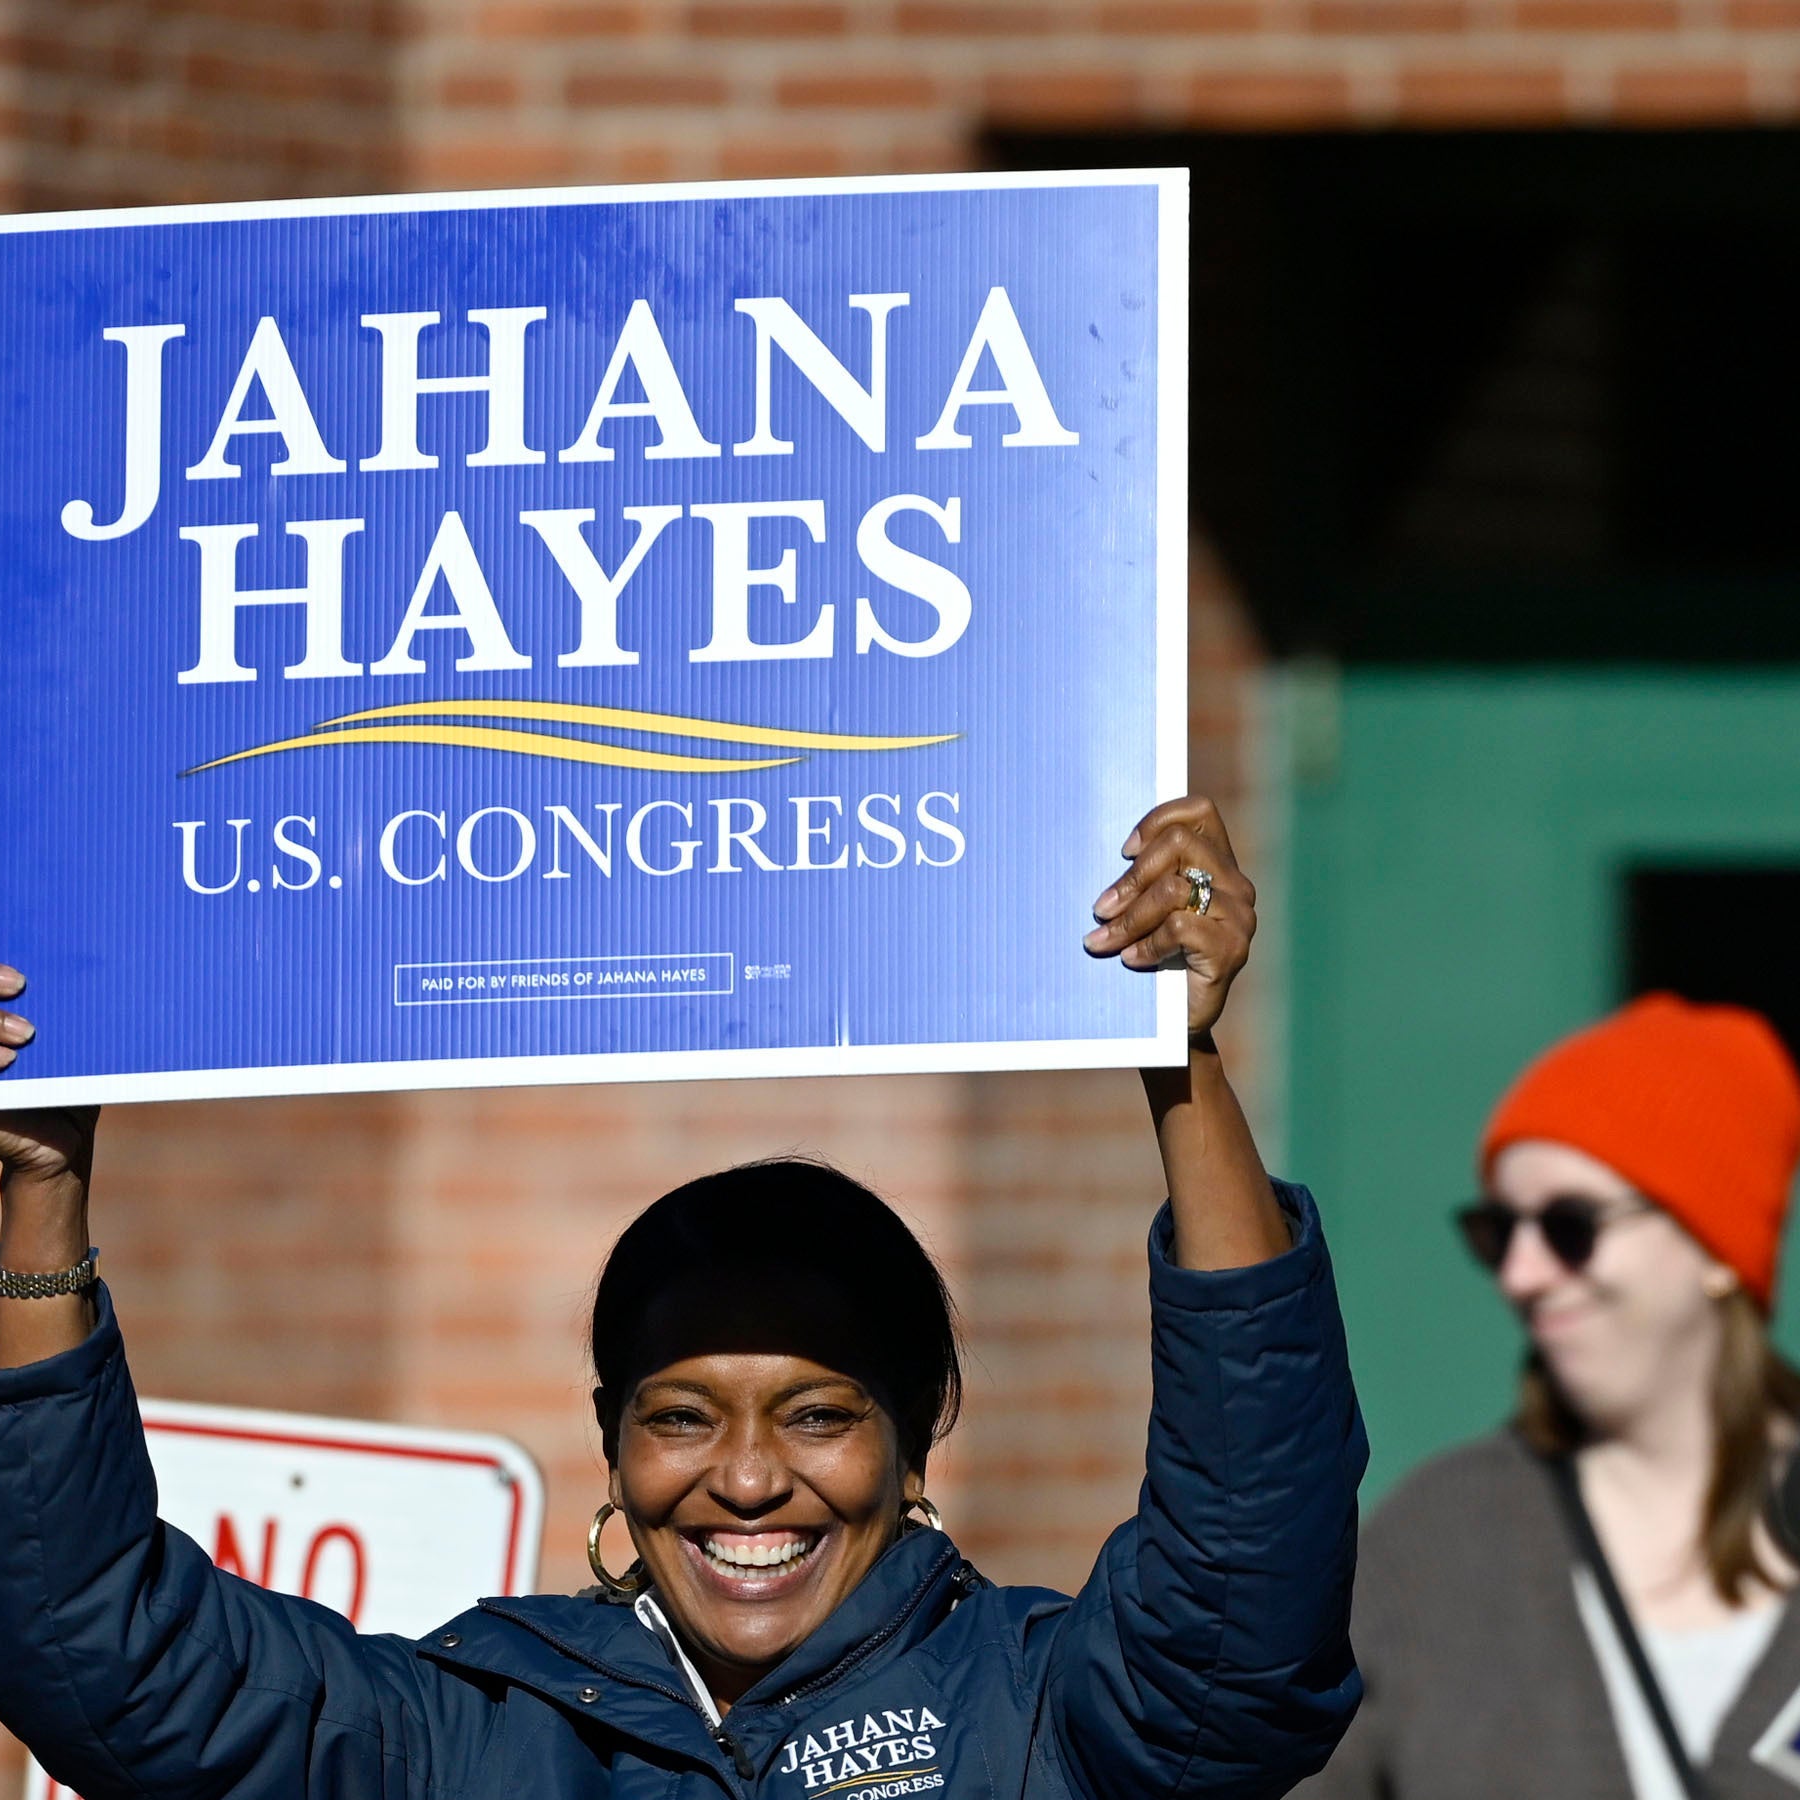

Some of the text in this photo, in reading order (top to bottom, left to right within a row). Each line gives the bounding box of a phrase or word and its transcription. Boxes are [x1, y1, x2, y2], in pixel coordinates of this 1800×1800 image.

[61, 287, 1080, 541] JAHANA
[177, 494, 973, 685] HAYES
[172, 791, 966, 895] U.S. CONGRESS
[422, 968, 706, 991] PAID FOR BY FRIENDS OF JAHANA HAYES
[781, 1706, 947, 1774] JAHANA
[802, 1733, 937, 1789] HAYES
